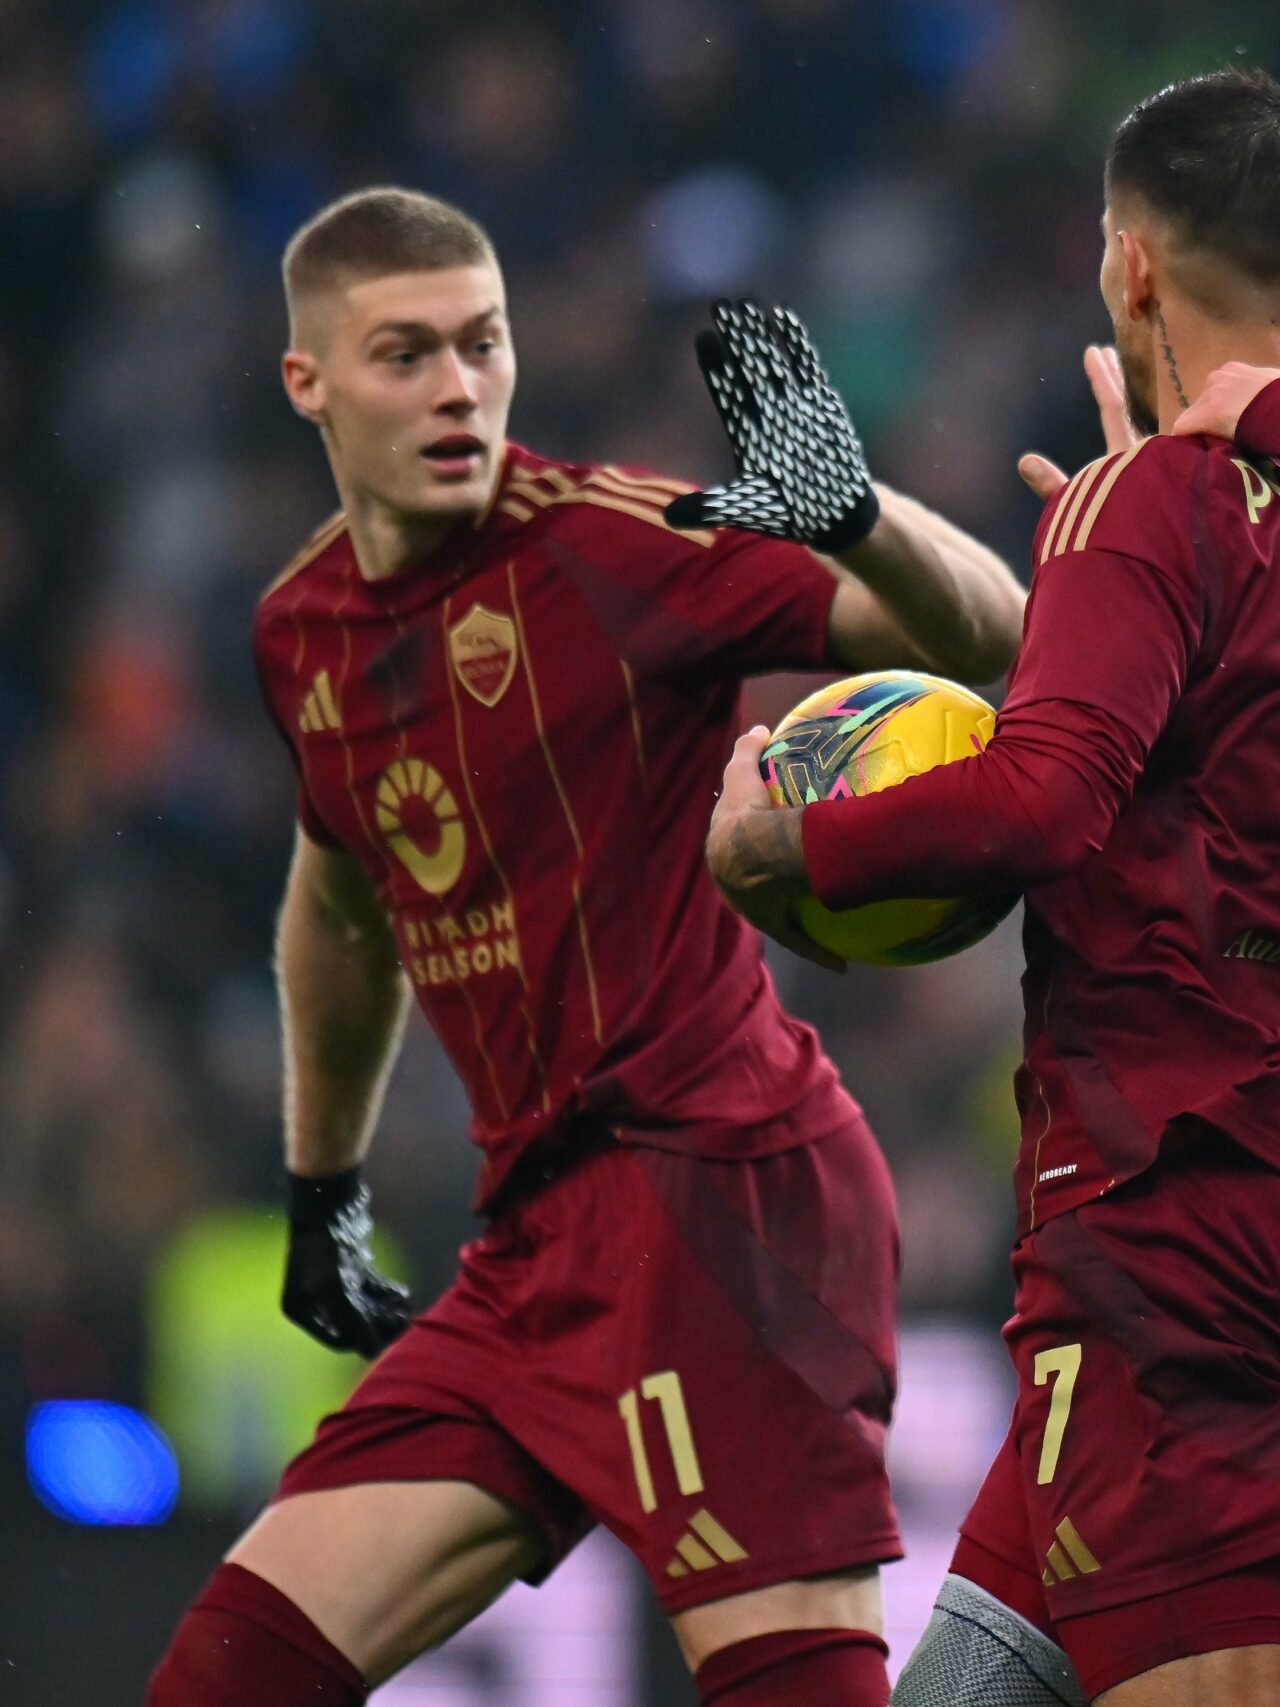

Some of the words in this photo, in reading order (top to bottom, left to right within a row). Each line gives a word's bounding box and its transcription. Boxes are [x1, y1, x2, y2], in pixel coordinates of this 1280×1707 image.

[413, 938, 520, 986] SEASON
[1038, 1163, 1078, 1183] AEROREADY
[618, 1369, 705, 1515] 11
[1034, 1343, 1082, 1486] 7
